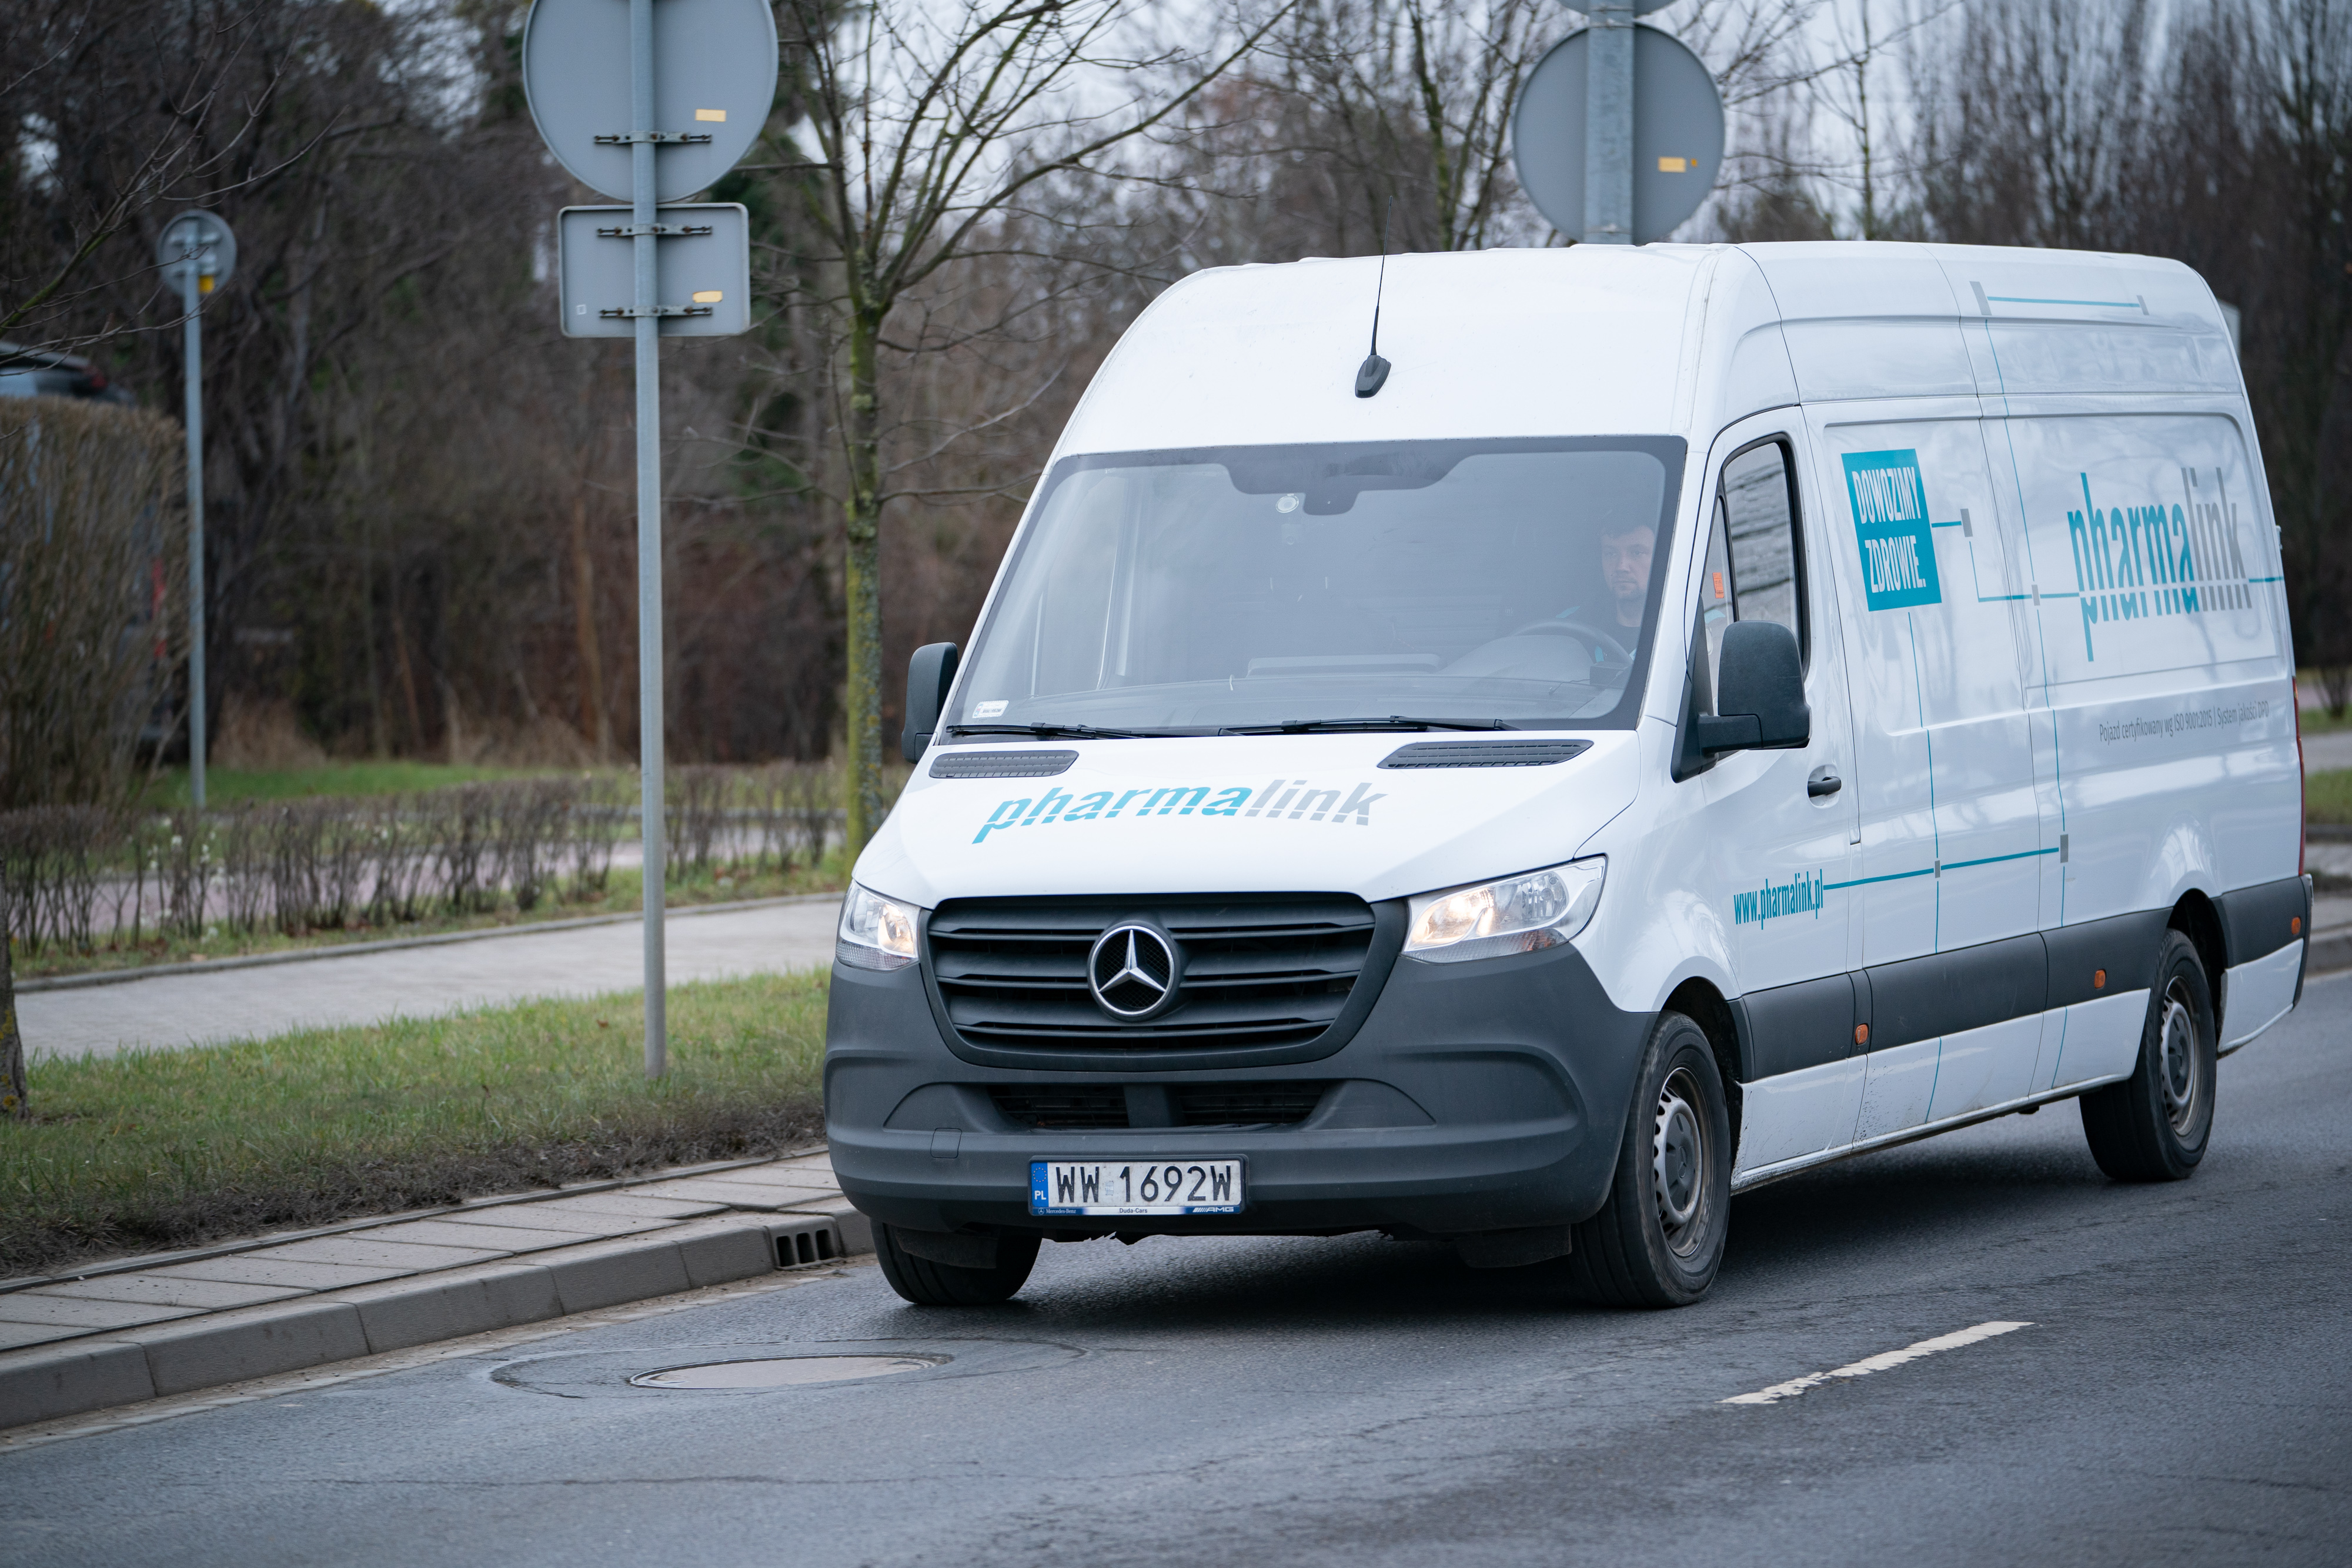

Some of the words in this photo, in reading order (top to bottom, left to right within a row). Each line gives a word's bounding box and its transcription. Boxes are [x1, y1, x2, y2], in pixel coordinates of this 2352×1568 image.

[1852, 466, 1921, 524] DOWOZIMY
[1865, 535, 1926, 593] ZDROWIE.
[2067, 467, 2252, 662] pharmalink
[2099, 721, 2120, 745] Pojazd
[2122, 717, 2163, 742] certyfikowany
[2164, 717, 2174, 737] wg
[2173, 713, 2184, 732] ISO
[2185, 709, 2213, 730] 9001:2015
[2217, 707, 2237, 729] System
[2237, 700, 2257, 726] jakości
[971, 779, 1388, 845] pharmalink
[1733, 868, 1823, 930] www.pharmalink.pl
[1034, 1190, 1047, 1201] PL
[1055, 1166, 1100, 1203] WW
[1119, 1165, 1231, 1202] 1692W
